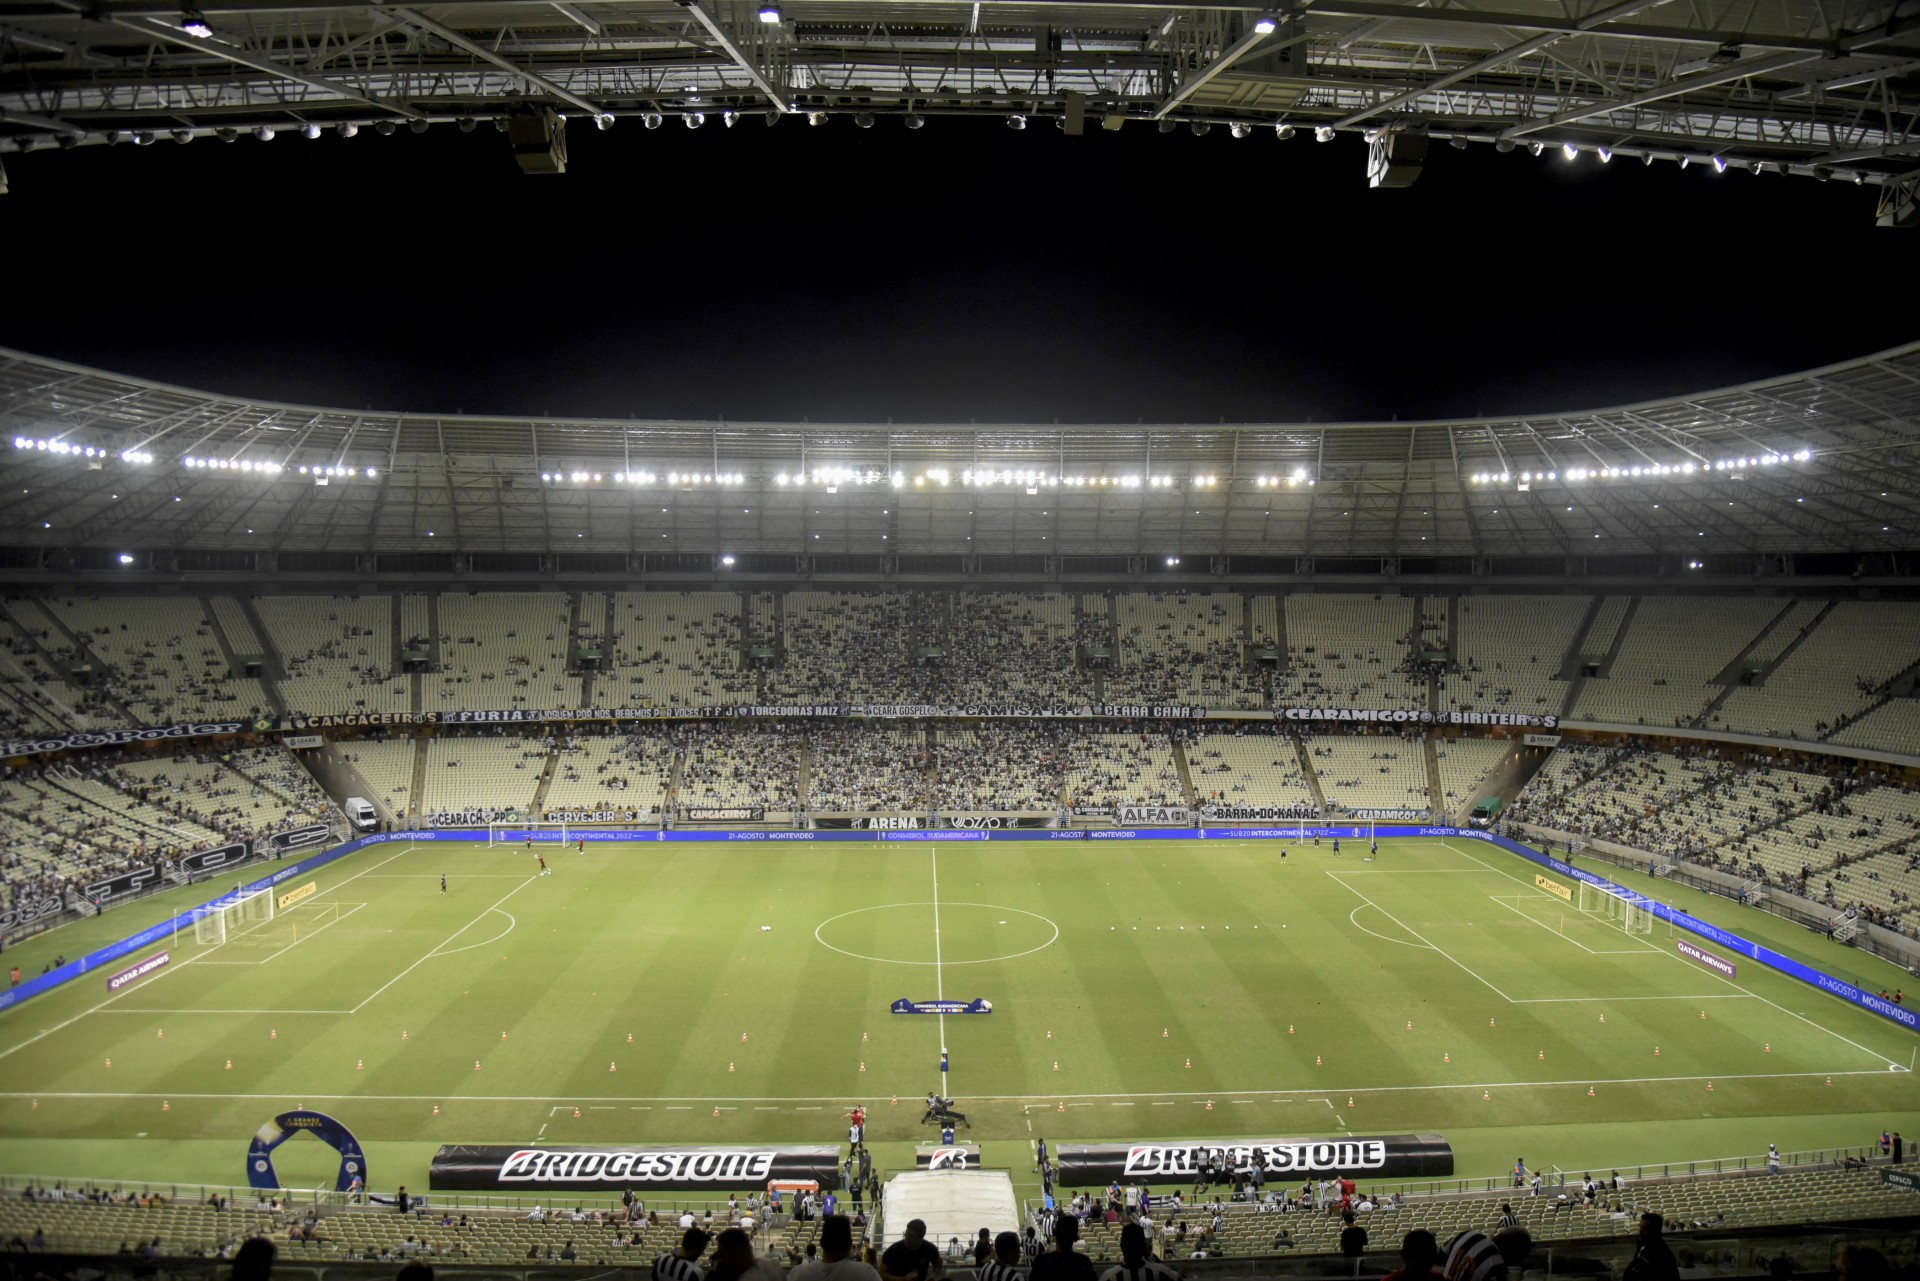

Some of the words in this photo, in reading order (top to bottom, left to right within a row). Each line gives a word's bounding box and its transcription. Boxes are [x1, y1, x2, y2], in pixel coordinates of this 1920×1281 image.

[615, 708, 651, 719] BEBEMOS
[750, 706, 813, 716] TORCEDORAS
[815, 706, 838, 716] RAIZ
[900, 706, 928, 716] GOSPEL
[964, 705, 1044, 717] CAMISA
[1050, 705, 1067, 717] 14
[1153, 706, 1191, 718] CANA
[1285, 708, 1420, 721] CEARAMIGOS
[690, 809, 751, 820] CANGACEIROS
[1123, 808, 1170, 821] ALFA
[1356, 809, 1417, 821] CEARAMIGOS
[868, 817, 919, 829] ARENA
[390, 831, 435, 841] MONTEVIDEO
[728, 832, 765, 840] 21-AGOSTO
[769, 832, 815, 840] MONTEVIDEO
[1419, 828, 1455, 836] 21-AGOSTO
[1571, 868, 1599, 885] MONTEVIDEO
[289, 885, 314, 902] betfair
[1545, 880, 1569, 898] betfair
[1677, 942, 1701, 959] QATAR
[1701, 954, 1733, 975] AIRWAYS
[111, 968, 139, 988] QATAR
[138, 953, 169, 976] AIRWAYS
[1818, 975, 1858, 1000] 21-AGOSTO
[1861, 994, 1916, 1026] MONTEVIDEO
[499, 1150, 777, 1182] BRIDGESTONE
